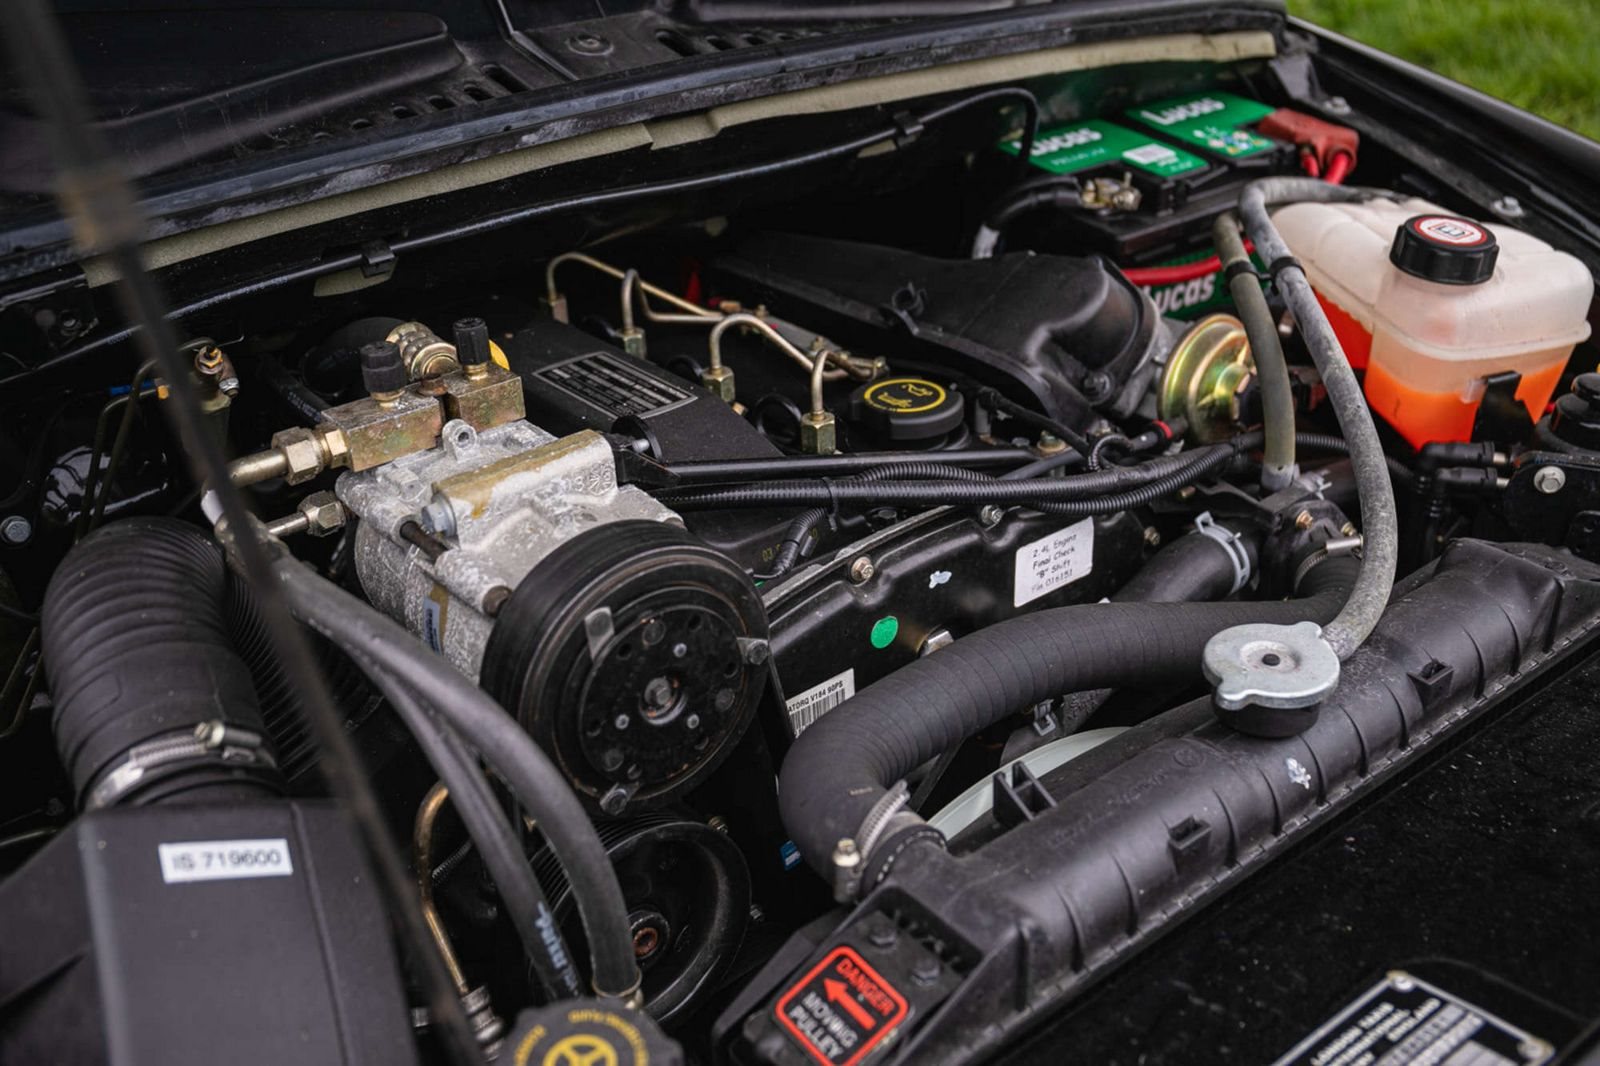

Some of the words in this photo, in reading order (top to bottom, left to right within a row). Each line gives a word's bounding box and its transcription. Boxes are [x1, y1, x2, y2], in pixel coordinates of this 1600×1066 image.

[1054, 534, 1077, 548] Engine
[1033, 558, 1051, 570] Final
[1054, 547, 1075, 560] Check
[1051, 560, 1070, 573] Shift
[788, 698, 809, 711] ATORQ
[201, 848, 283, 868] 719600
[835, 957, 896, 1017] DANGER
[801, 991, 858, 1048] MOVING
[788, 1005, 844, 1059] PULLEY
